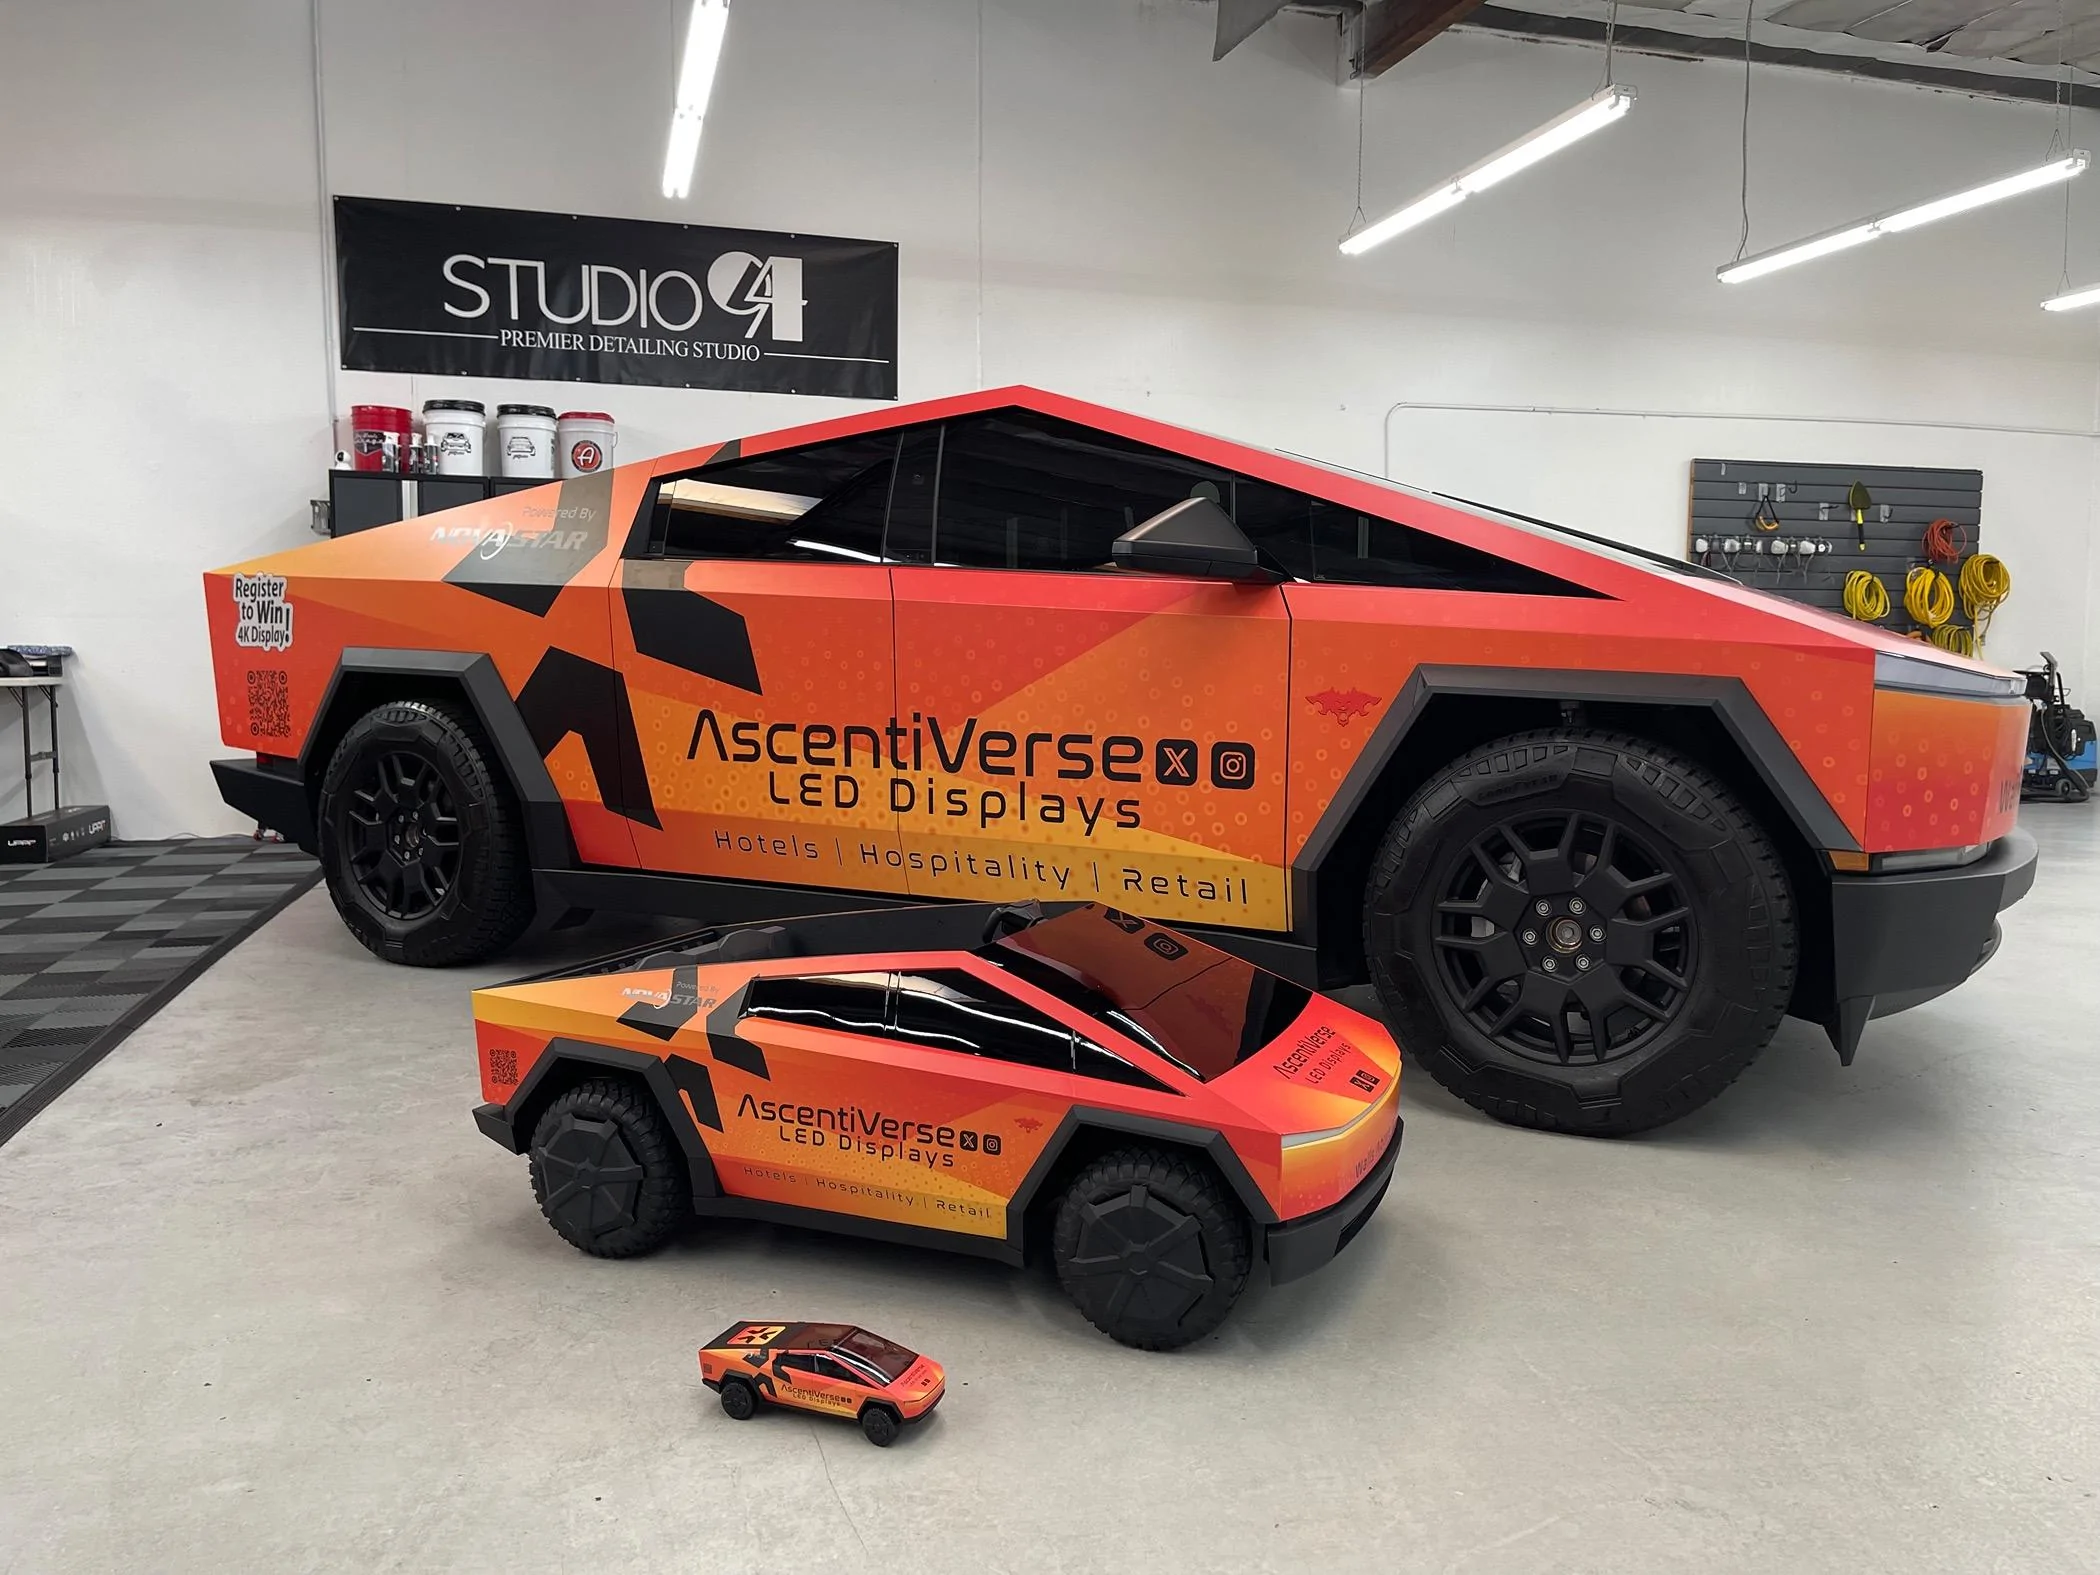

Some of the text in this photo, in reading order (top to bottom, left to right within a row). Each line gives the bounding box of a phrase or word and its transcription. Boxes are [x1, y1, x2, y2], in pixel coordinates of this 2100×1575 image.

[443, 254, 702, 331] STUDIO
[500, 329, 760, 361] PREMIER DETAILING STUDIO
[522, 506, 596, 522] Powered By
[235, 577, 284, 603] Register
[242, 602, 254, 620] to
[238, 626, 249, 642] 4K
[686, 709, 1143, 783] AscentiVerse
[769, 771, 1141, 837] LED Displays
[714, 830, 818, 859] Hotels
[860, 843, 1070, 891] Hospitality
[1122, 868, 1248, 905] Retail
[1273, 1025, 1336, 1080] AscentiVerse
[1305, 1042, 1351, 1084] LED Displays
[738, 1094, 955, 1148] AscentiVerse
[779, 1125, 954, 1169] LED Displays
[743, 1167, 796, 1183] Hotels
[817, 1178, 913, 1206] Hospitality
[936, 1199, 990, 1218] Retail
[781, 1384, 840, 1401] AscentiVerse
[809, 1396, 840, 1407] Displays
